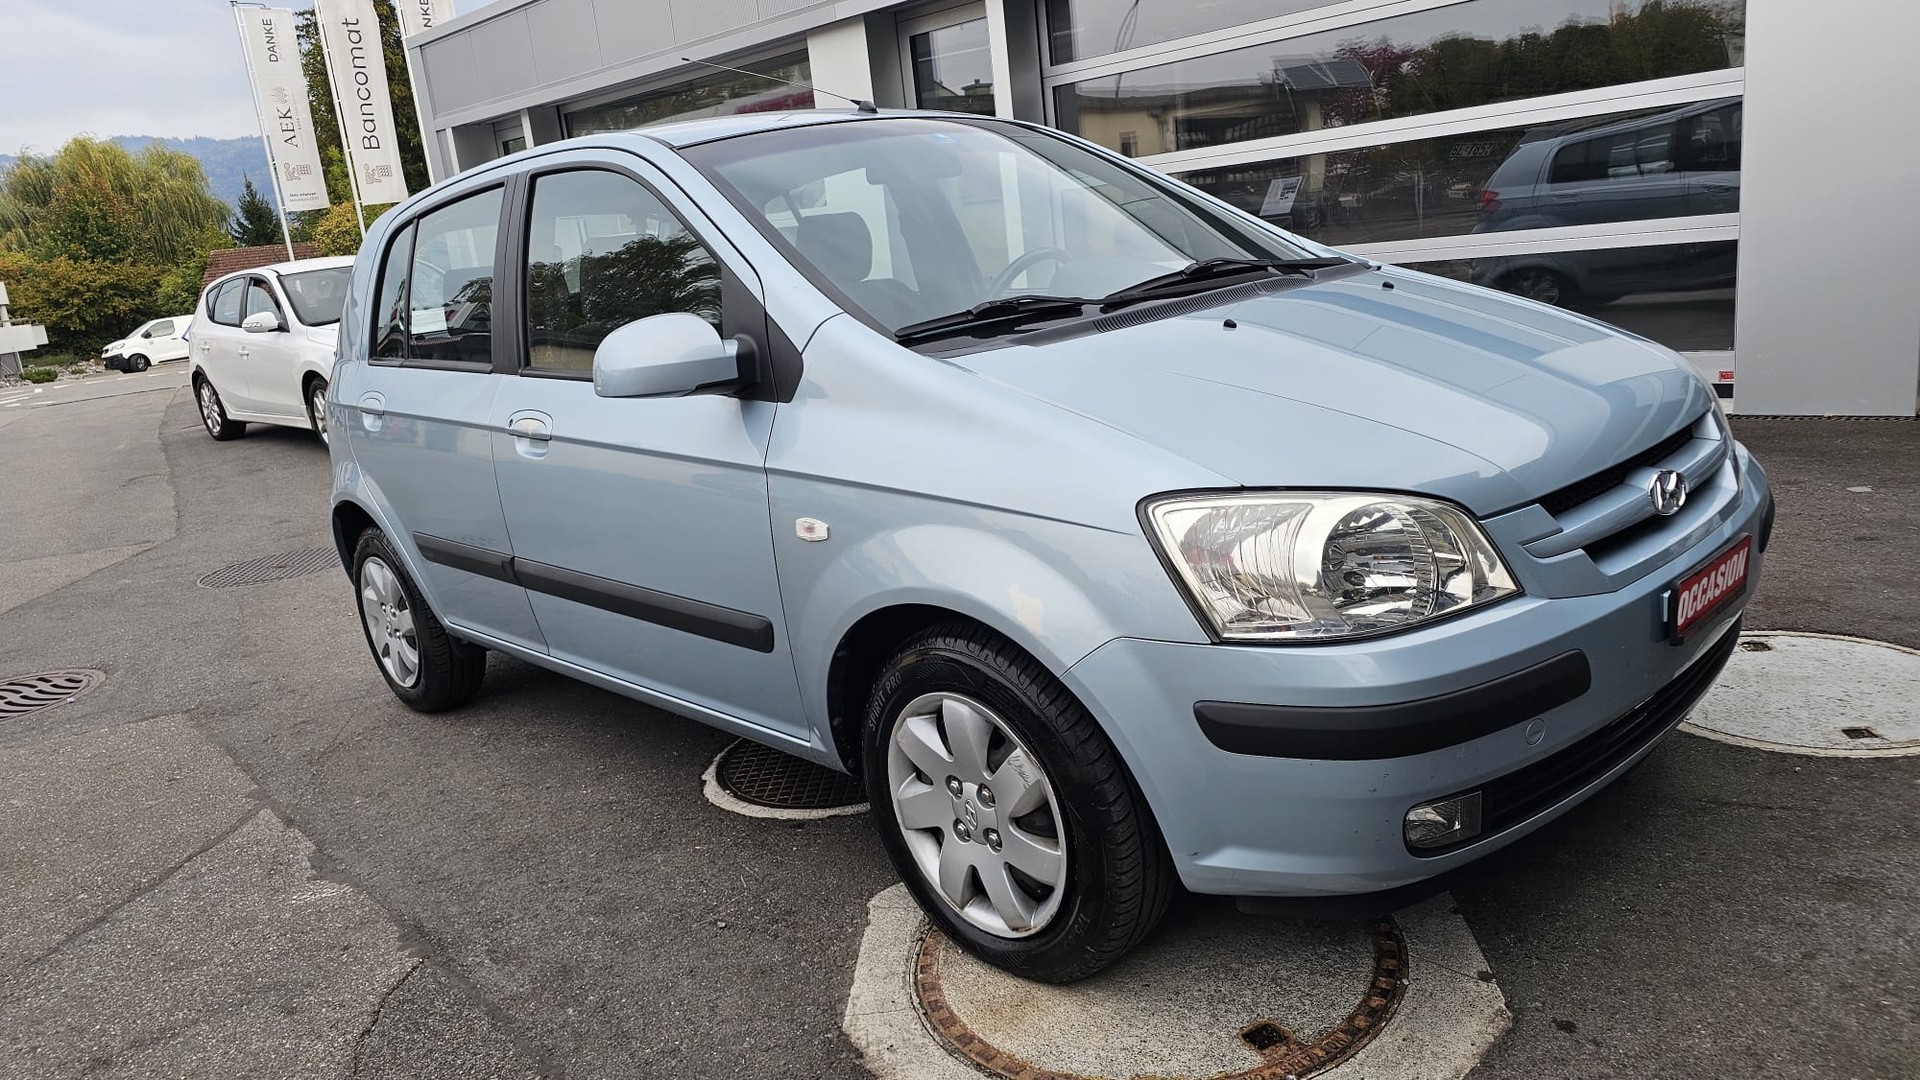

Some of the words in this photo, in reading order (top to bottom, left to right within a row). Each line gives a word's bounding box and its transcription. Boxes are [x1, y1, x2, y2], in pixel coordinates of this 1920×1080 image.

[419, 0, 432, 28] NKE
[262, 18, 279, 62] DANKE
[342, 17, 380, 150] Bancomat
[276, 106, 299, 148] AEK
[1677, 547, 1749, 626] OCCASION
[869, 689, 886, 731] SPIRIT
